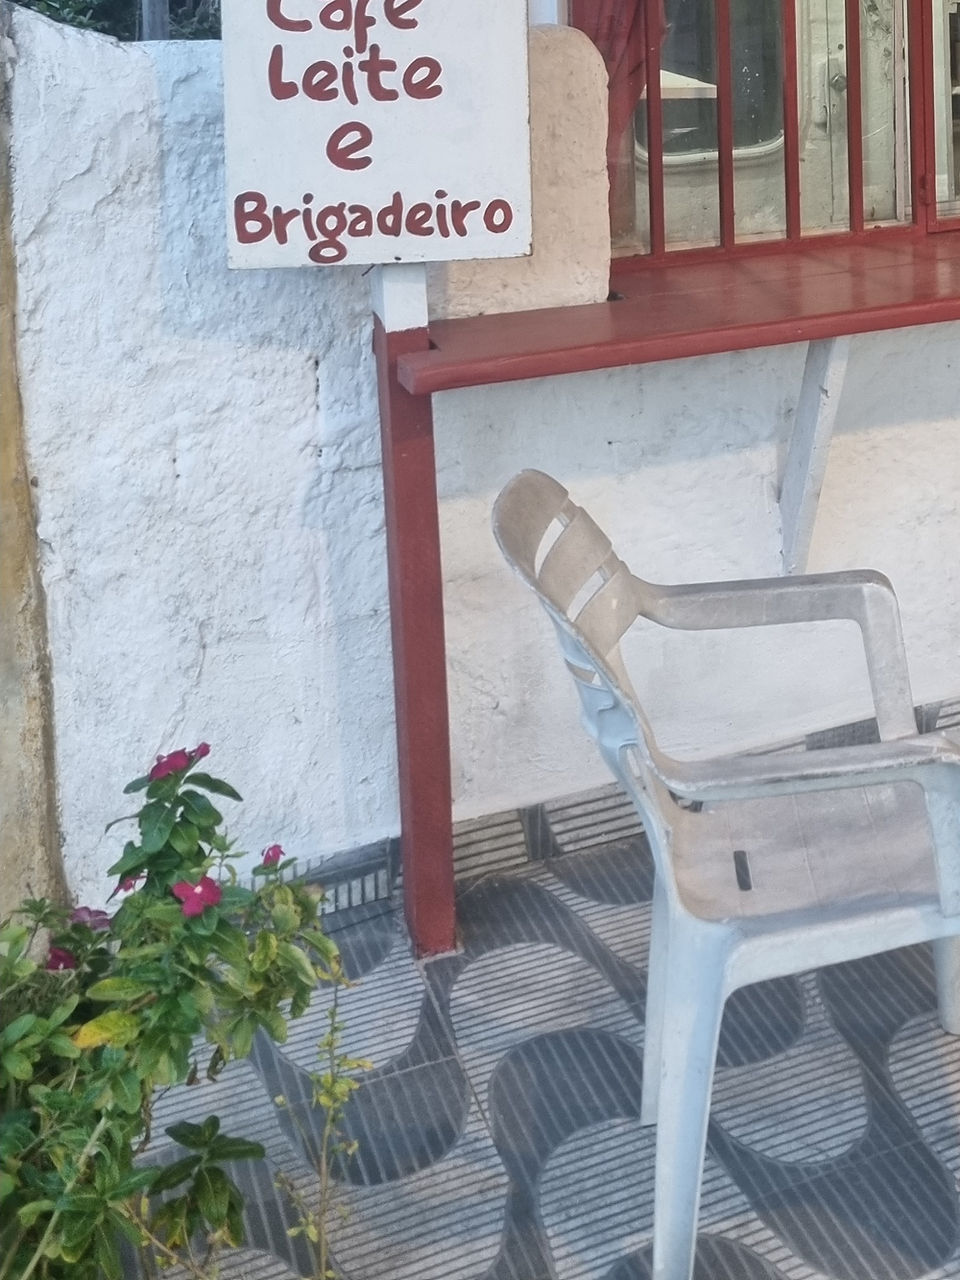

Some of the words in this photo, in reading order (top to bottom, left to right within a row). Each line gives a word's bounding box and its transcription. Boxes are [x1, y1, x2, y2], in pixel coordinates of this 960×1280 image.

[268, 44, 444, 105] Leite
[326, 121, 374, 172] e
[233, 190, 514, 265] Brigadeiro
